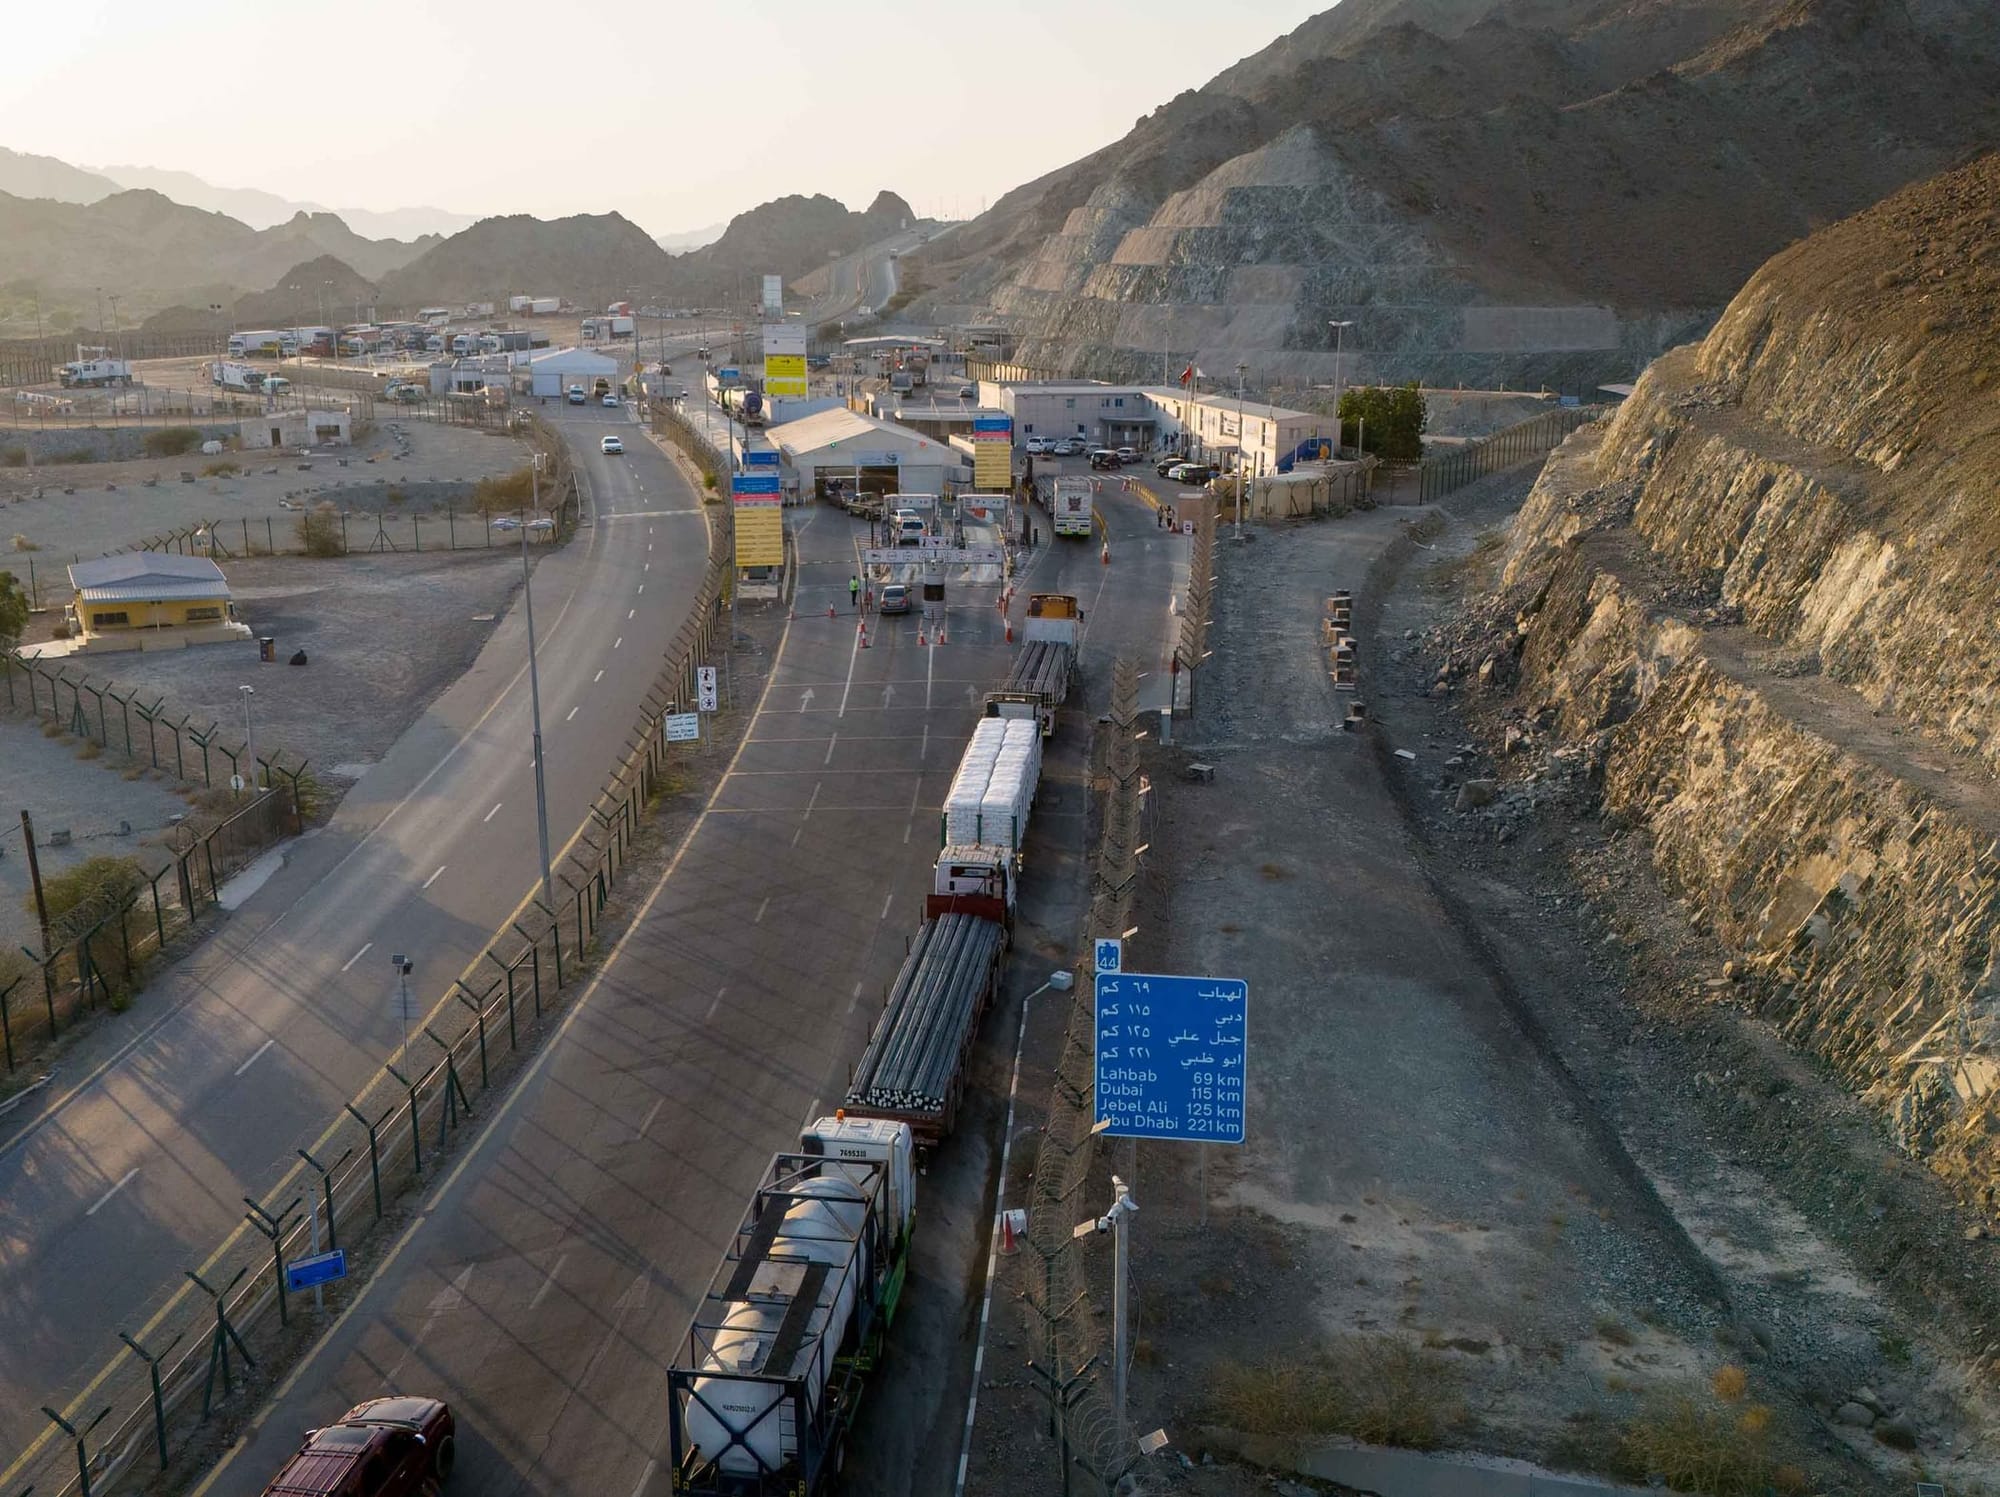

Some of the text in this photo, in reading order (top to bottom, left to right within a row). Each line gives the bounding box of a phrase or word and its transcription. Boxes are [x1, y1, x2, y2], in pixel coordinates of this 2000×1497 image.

[1100, 957, 1116, 969] 44
[1101, 981, 1119, 996] كم
[1132, 982, 1150, 993] ٦٩
[1101, 1003, 1242, 1028] دبي ١١٥ كم
[1101, 1025, 1241, 1047] جبل علي ١٢٥ كم
[1101, 1046, 1119, 1062] كم
[1128, 1047, 1150, 1058] ٢٢١
[1180, 1052, 1215, 1070] ظبي
[1100, 1066, 1240, 1087] Lahbab 69 km
[1100, 1082, 1240, 1102] Dubai 115 km
[1099, 1098, 1240, 1118] Jebel Ali 125 km
[1135, 1115, 1178, 1130] Dhabi
[1187, 1118, 1213, 1132] 221
[1216, 1119, 1240, 1133] km
